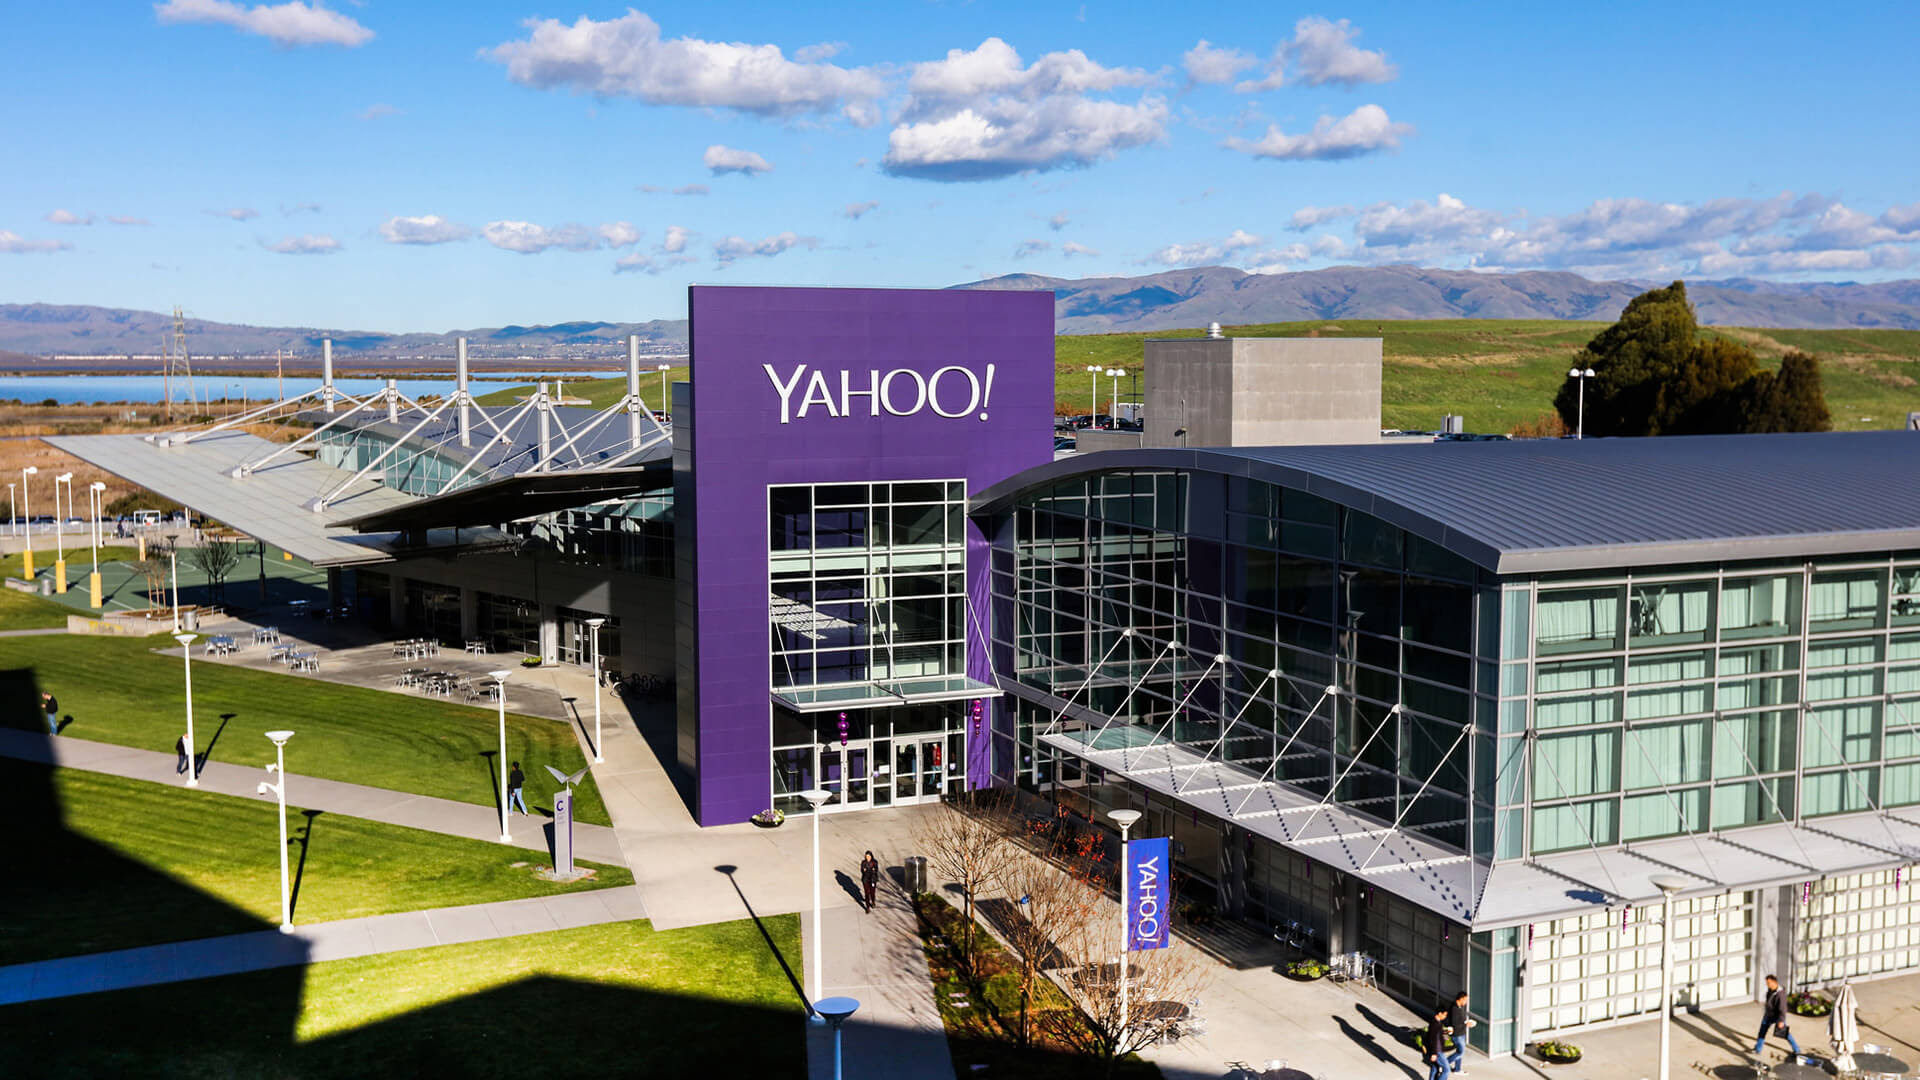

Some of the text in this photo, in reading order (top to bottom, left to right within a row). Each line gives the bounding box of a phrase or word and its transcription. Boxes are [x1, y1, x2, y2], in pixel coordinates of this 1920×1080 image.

[762, 363, 995, 424] YAHOO!
[556, 800, 564, 811] C
[1137, 856, 1159, 942] YAHOO!
